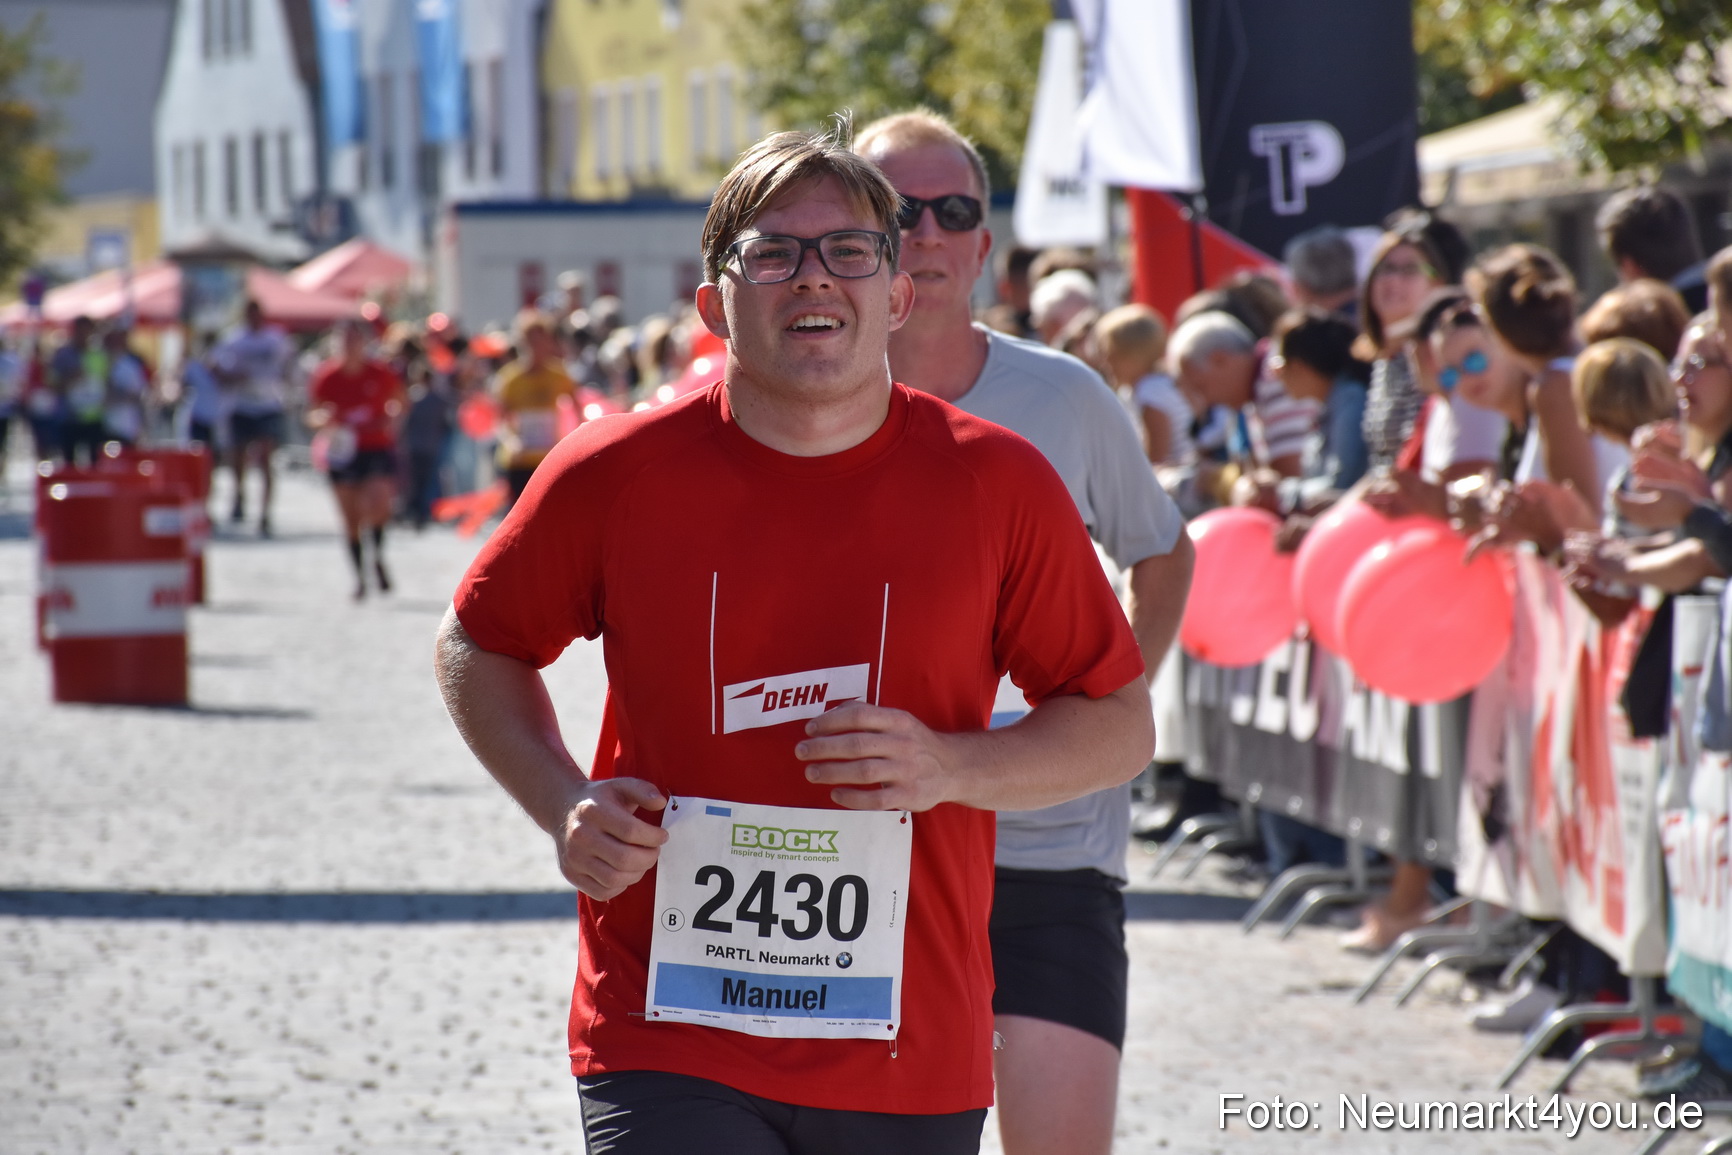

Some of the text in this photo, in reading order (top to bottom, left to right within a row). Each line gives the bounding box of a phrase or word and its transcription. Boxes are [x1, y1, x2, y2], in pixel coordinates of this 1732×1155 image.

[761, 682, 829, 713] DEHN
[731, 823, 839, 854] BOCK
[730, 848, 840, 864] inspired by smart concepts
[692, 865, 869, 942] 2430
[668, 914, 677, 926] B
[706, 944, 830, 966] PARTL Neumarkt
[721, 977, 828, 1010] Manuel
